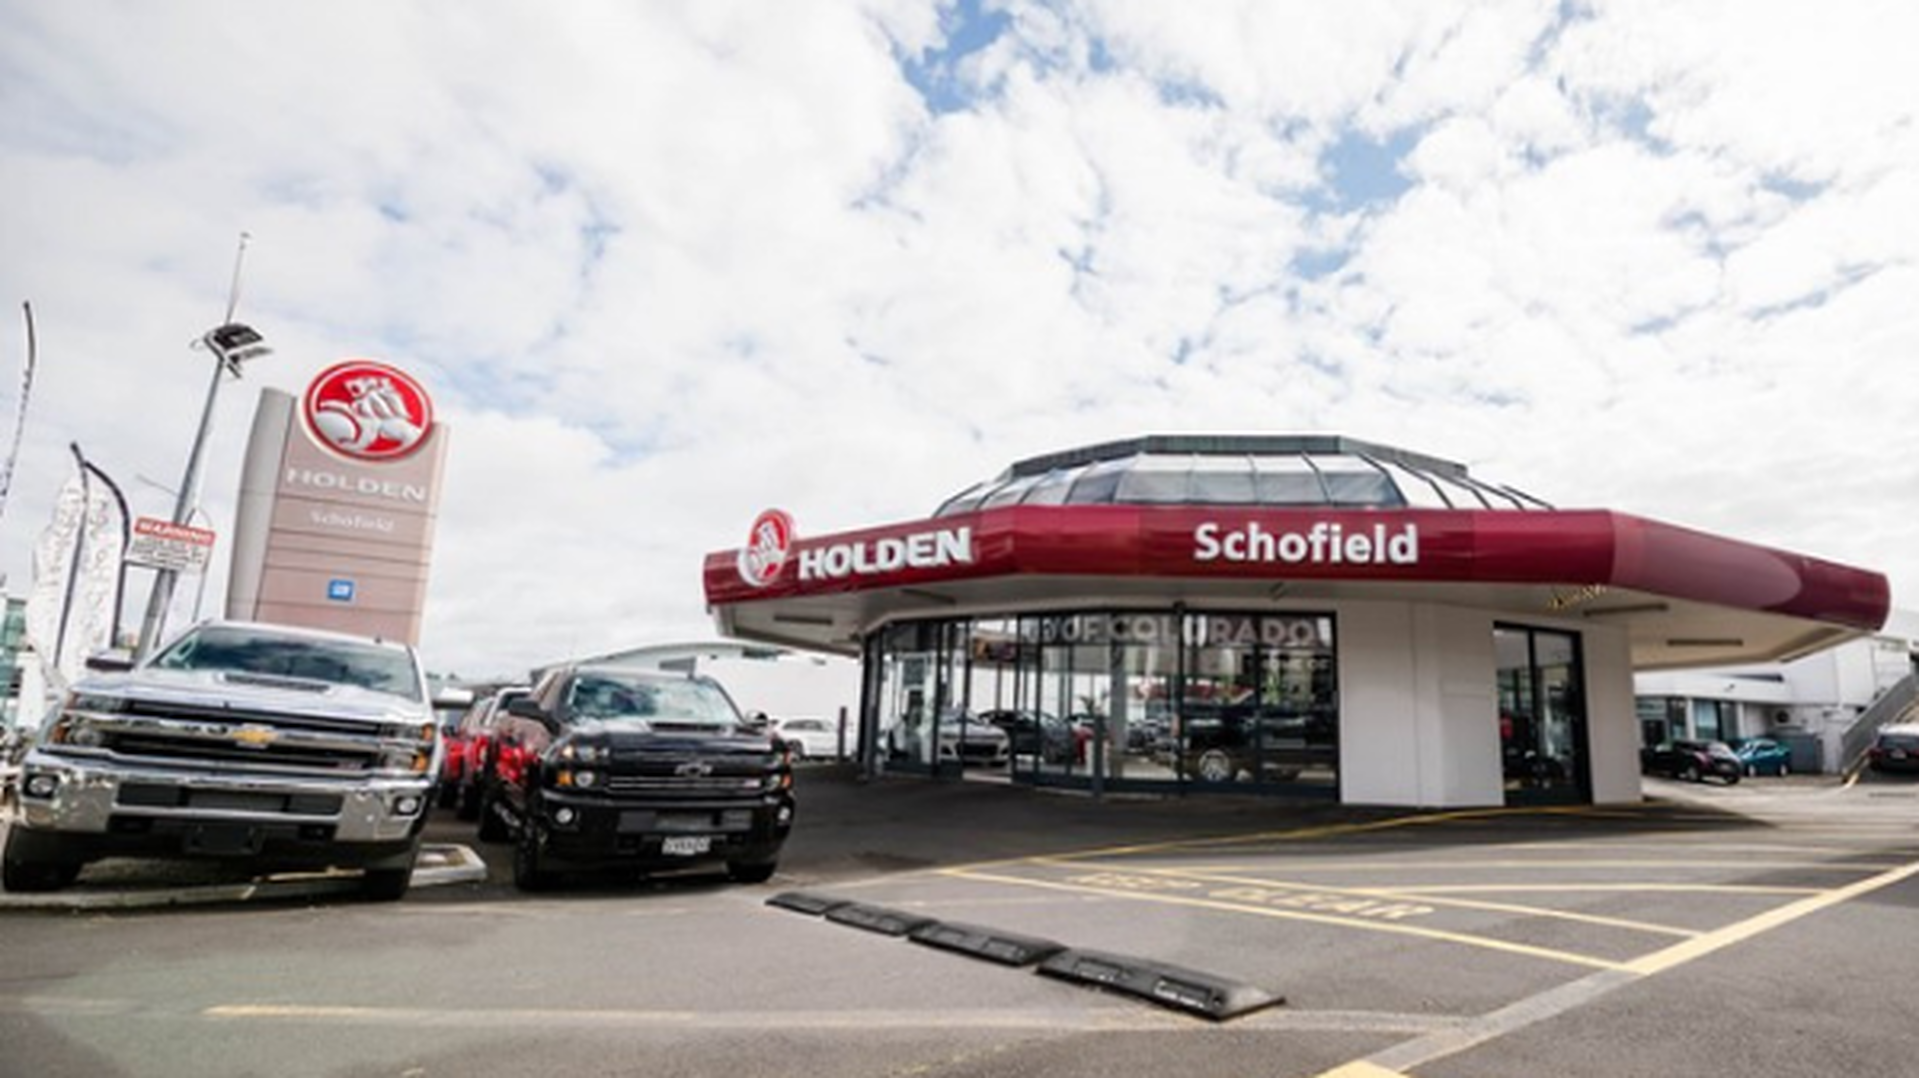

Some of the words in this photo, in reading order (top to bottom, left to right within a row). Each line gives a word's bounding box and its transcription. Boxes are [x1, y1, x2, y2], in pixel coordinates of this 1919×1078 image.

[287, 467, 427, 502] HOLDEN
[798, 526, 973, 581] HOLDEN
[1194, 521, 1419, 563] Schofield
